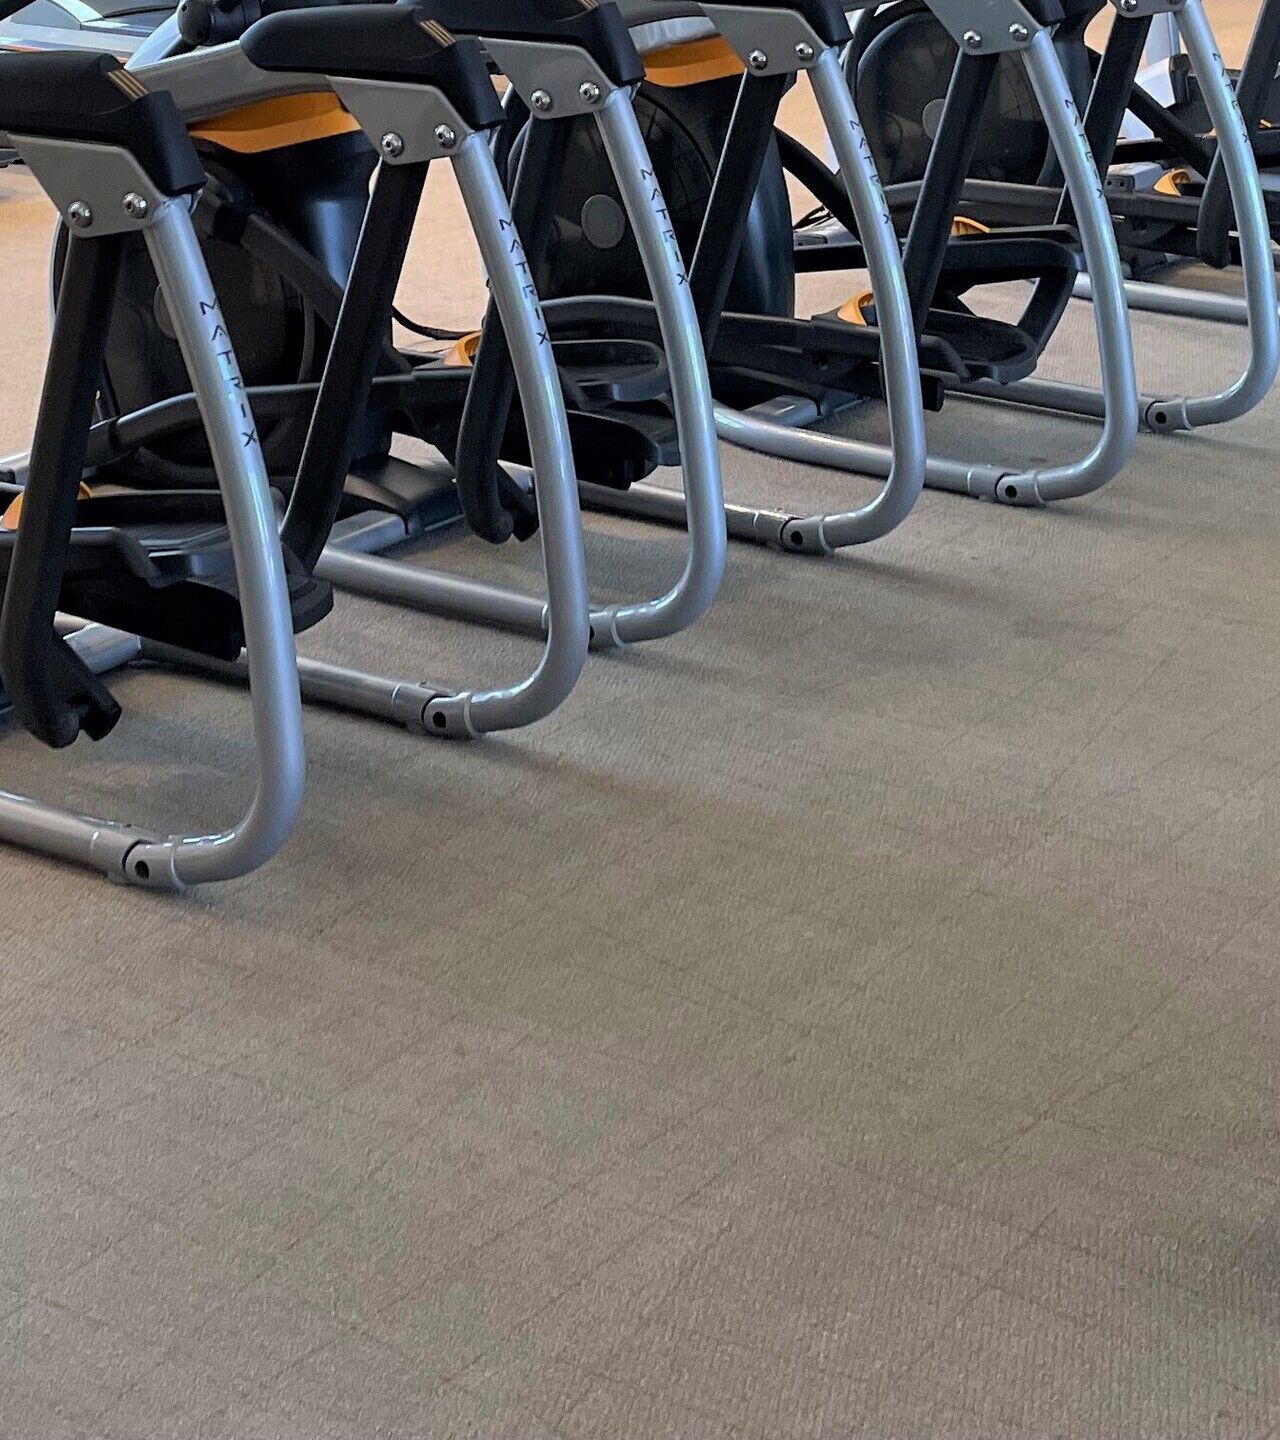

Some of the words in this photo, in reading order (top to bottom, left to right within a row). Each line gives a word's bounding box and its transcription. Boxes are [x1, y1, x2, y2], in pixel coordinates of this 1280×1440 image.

[499, 217, 550, 345] MATRIX
[640, 168, 688, 286] MATRIX
[200, 296, 257, 447] MATRIX
